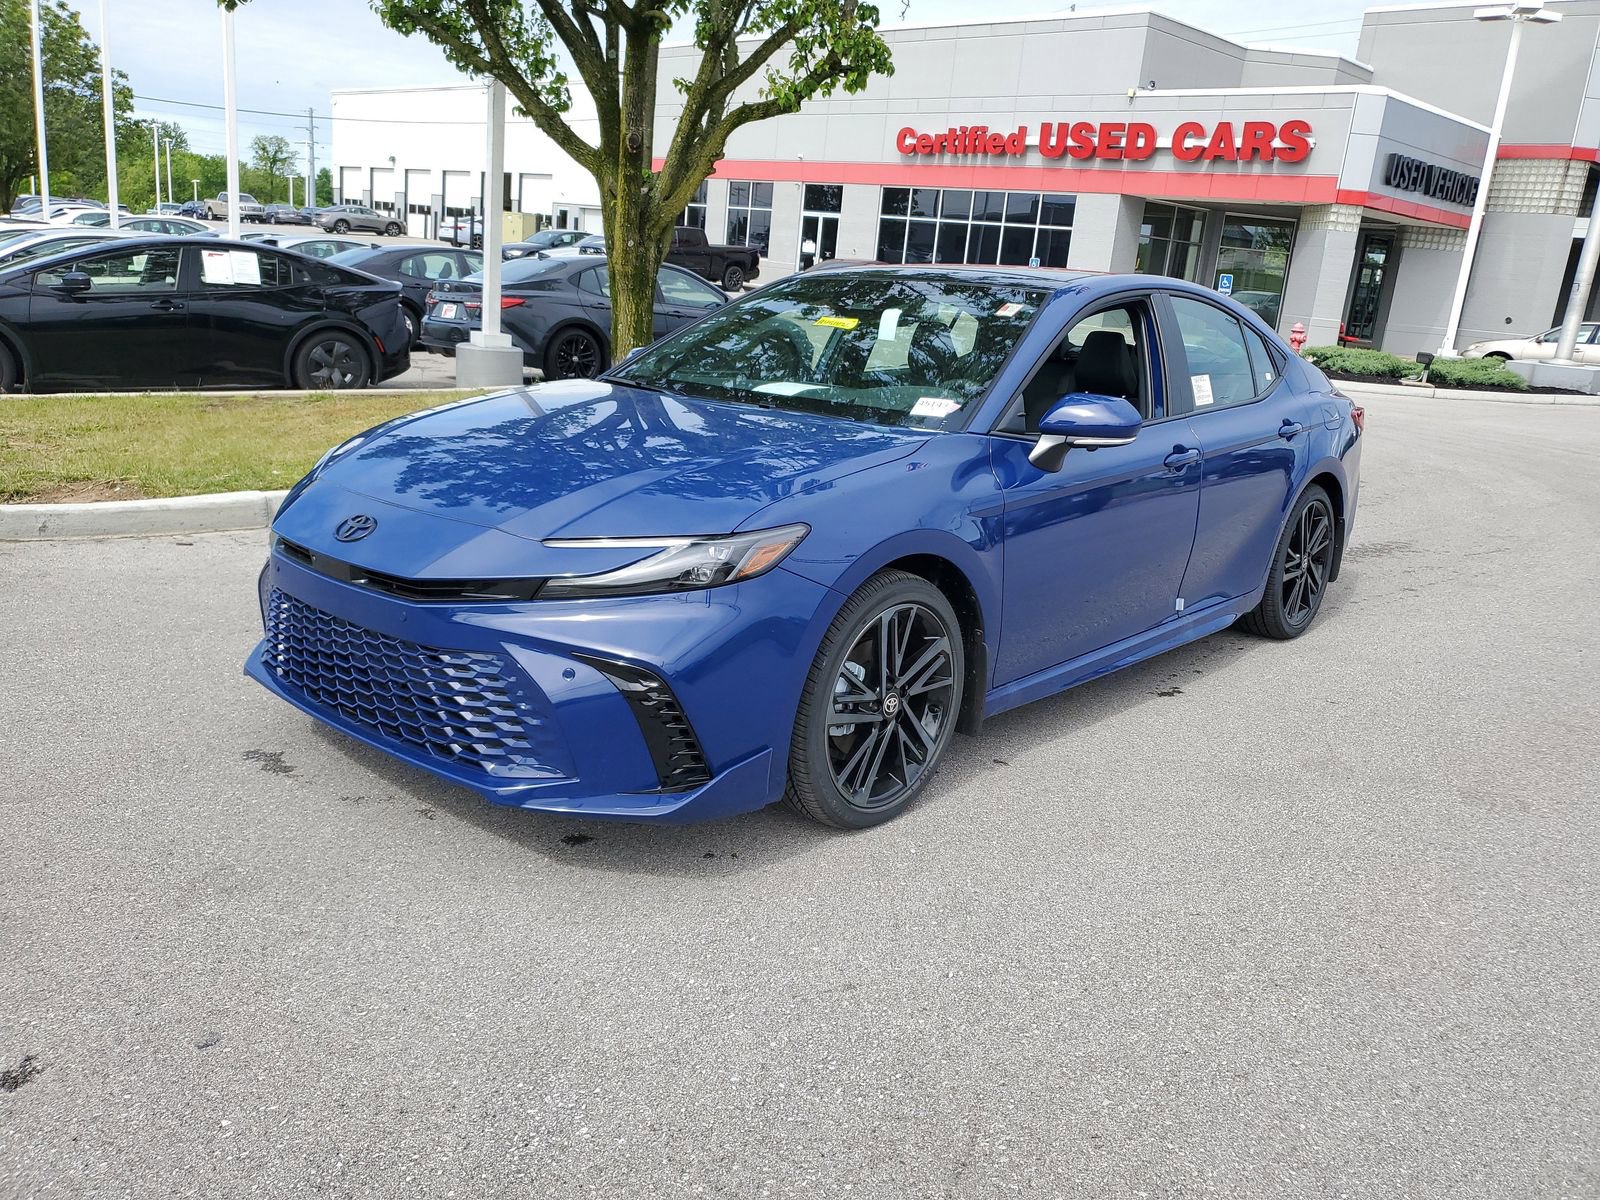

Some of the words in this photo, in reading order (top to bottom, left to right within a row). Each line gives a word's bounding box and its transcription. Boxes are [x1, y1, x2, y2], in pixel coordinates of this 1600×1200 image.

[896, 126, 1028, 155] Certified
[1038, 122, 1157, 160] USED
[1171, 119, 1313, 163] CARS
[1387, 153, 1428, 193] USED
[1429, 165, 1481, 207] VEHICLE
